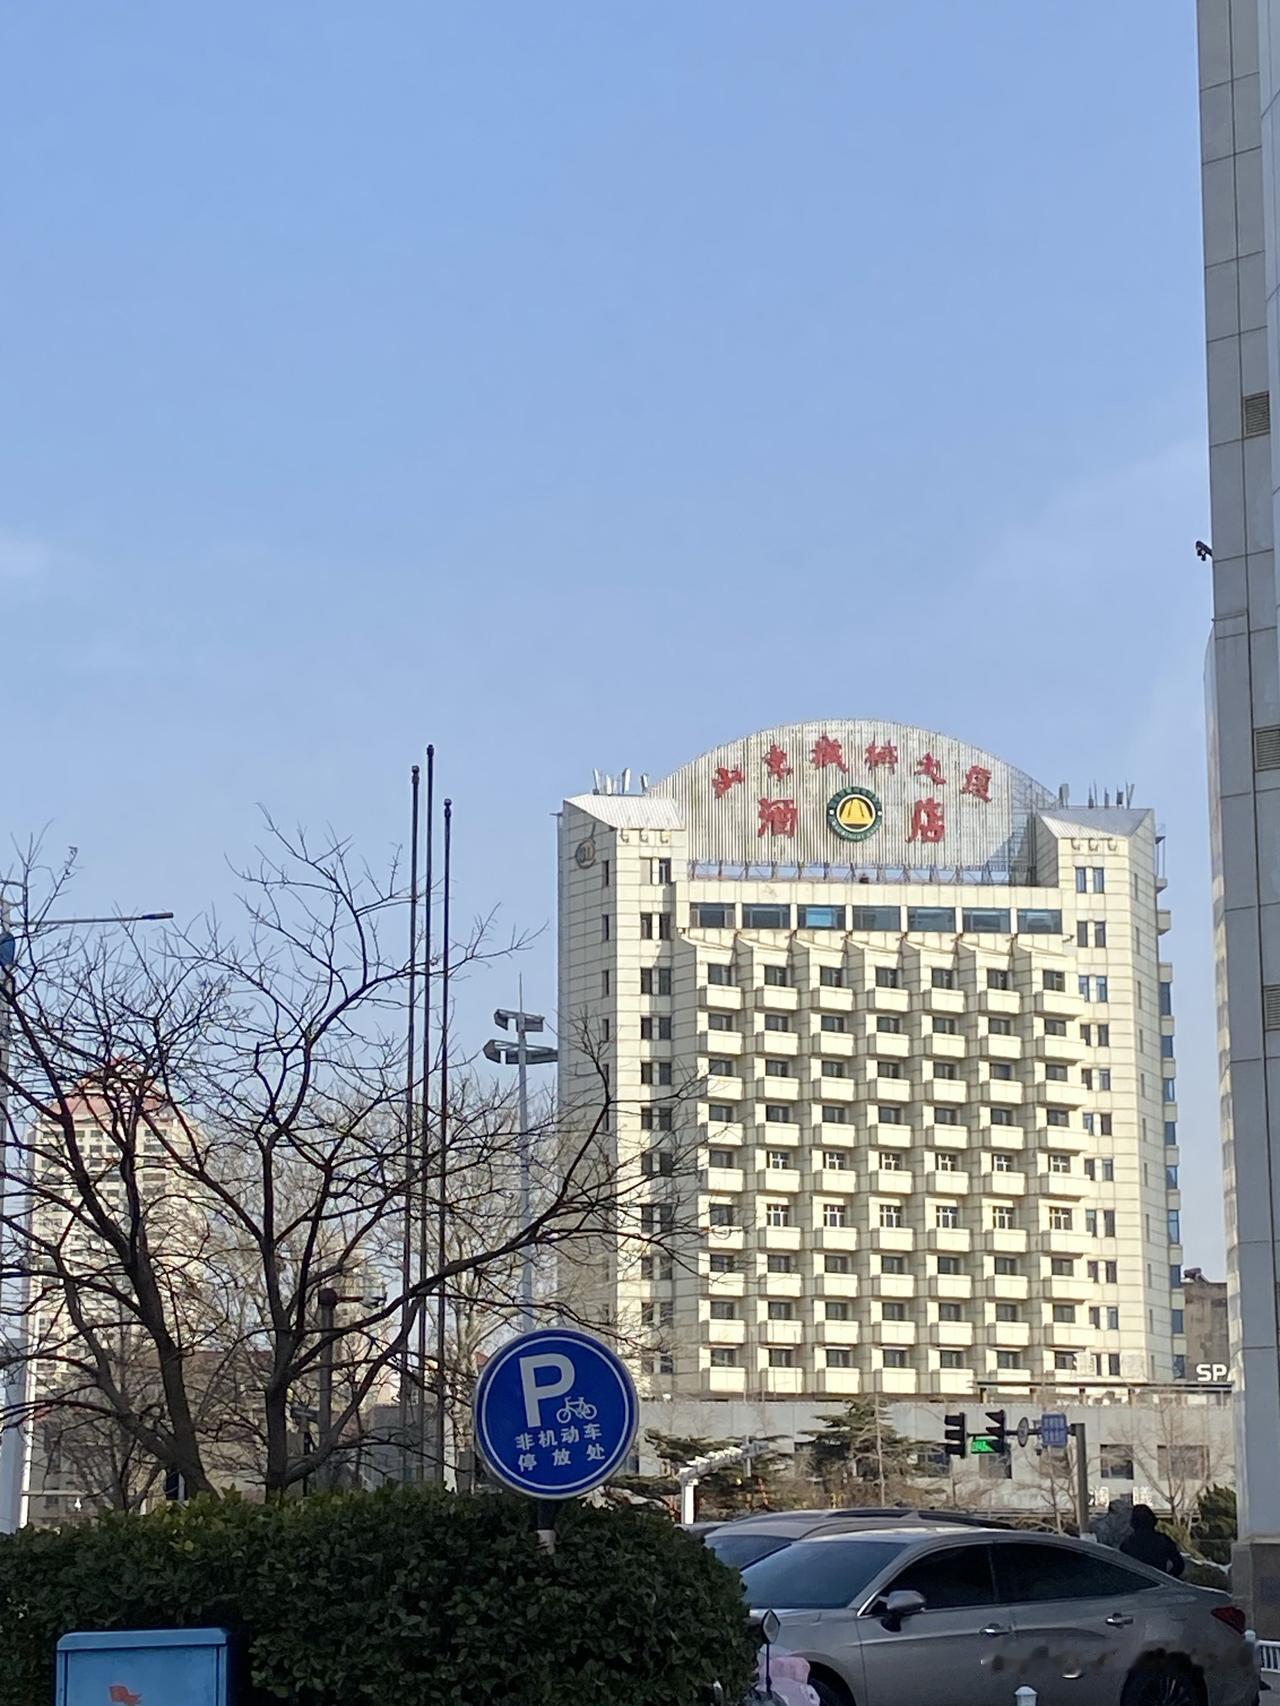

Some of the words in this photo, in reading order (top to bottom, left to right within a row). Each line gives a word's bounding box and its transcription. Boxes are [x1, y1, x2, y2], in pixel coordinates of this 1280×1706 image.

[1196, 1363, 1232, 1382] SP
[519, 1353, 576, 1428] P
[515, 1423, 602, 1451] 非机动车
[518, 1444, 606, 1472] 停放处
